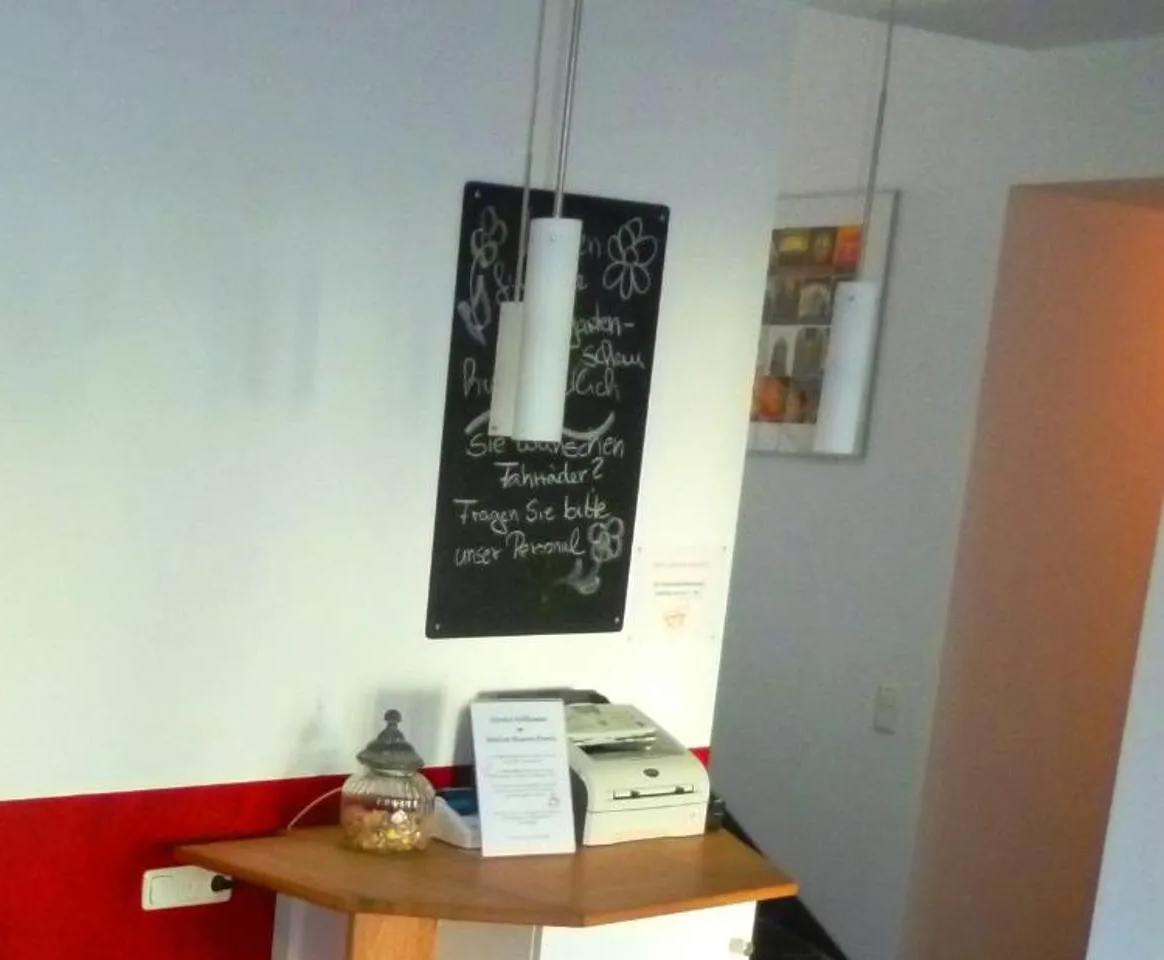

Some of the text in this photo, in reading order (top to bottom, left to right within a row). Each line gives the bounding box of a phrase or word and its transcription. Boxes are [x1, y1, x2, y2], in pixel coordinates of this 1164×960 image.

[465, 433, 505, 457] Sie
[452, 488, 612, 535] Fragen Sie bitte
[454, 529, 586, 567] unser Personal
